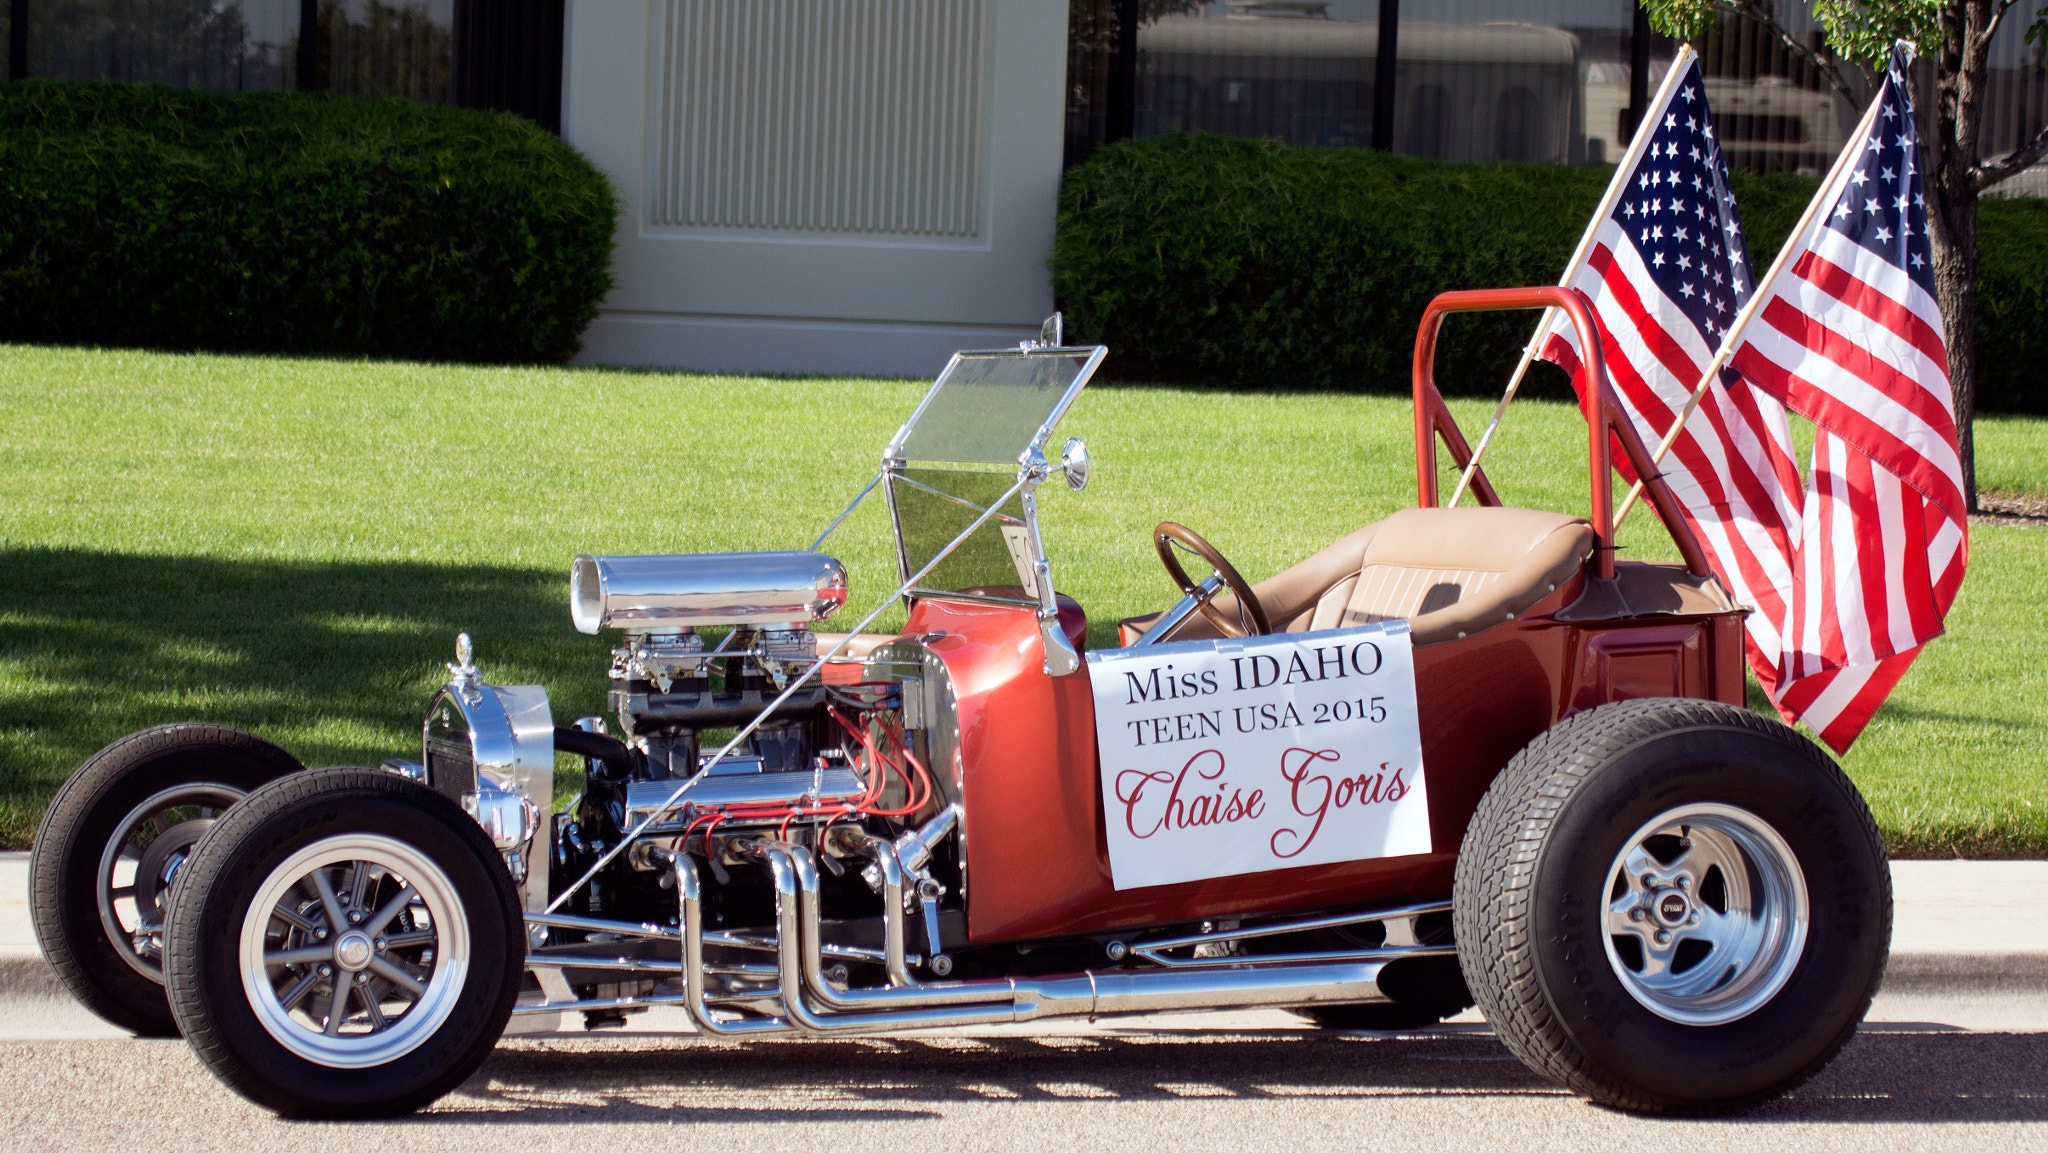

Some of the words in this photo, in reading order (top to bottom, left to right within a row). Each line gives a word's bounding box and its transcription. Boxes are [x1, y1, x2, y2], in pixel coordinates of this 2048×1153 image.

[1123, 664, 1218, 704] Miss
[1231, 642, 1382, 690] IDAHO
[1127, 710, 1221, 745] TEEN
[1233, 702, 1304, 733] USA
[1313, 697, 1386, 723] 2015
[1115, 749, 1265, 838] Chaise
[1271, 748, 1410, 858] Goris
